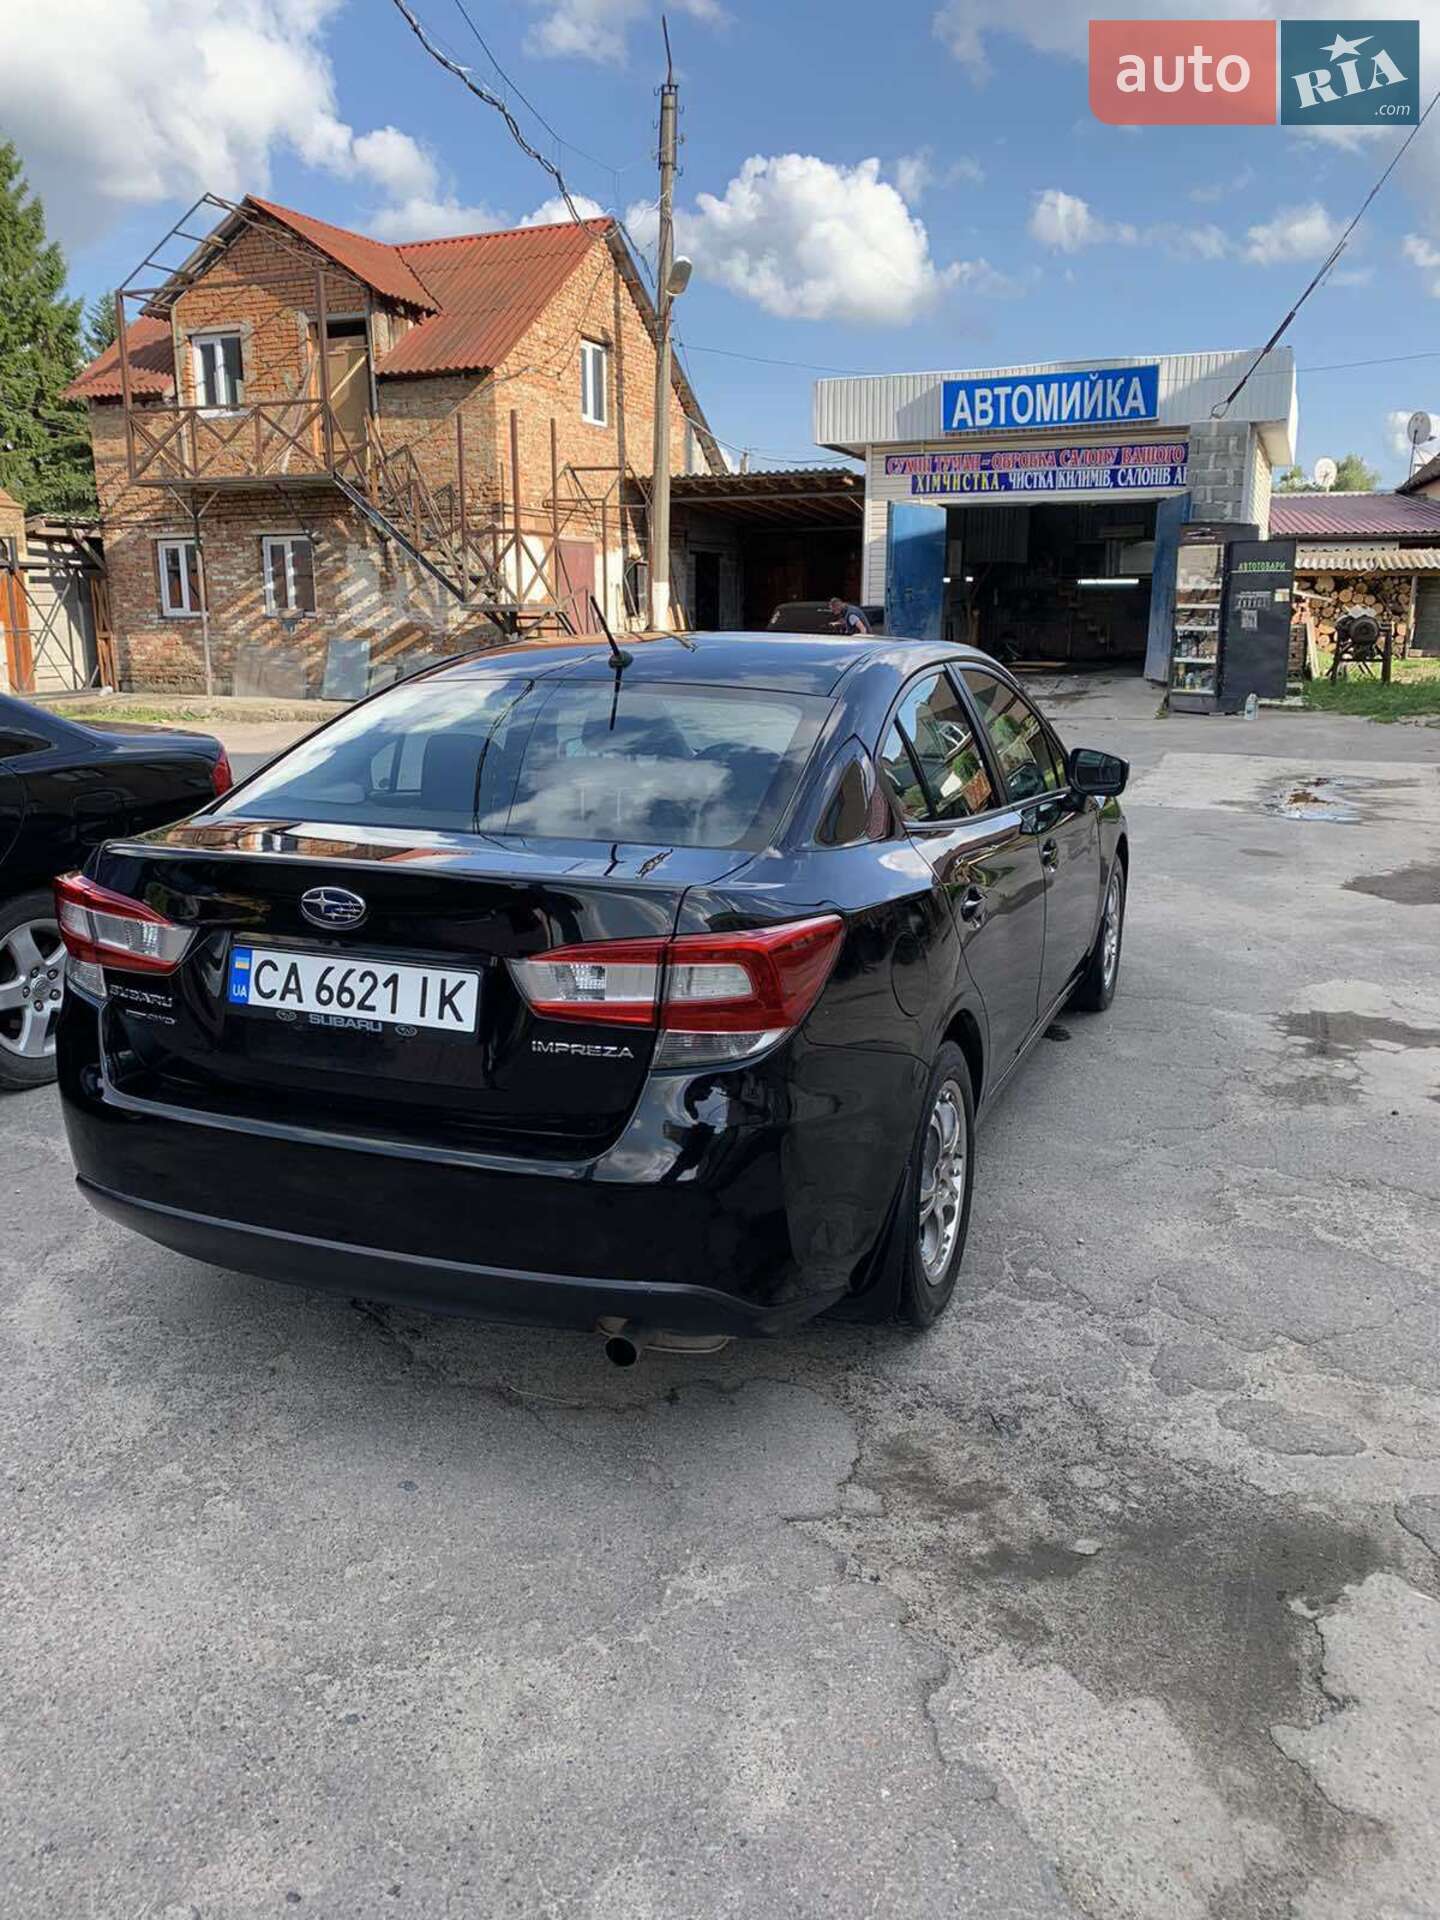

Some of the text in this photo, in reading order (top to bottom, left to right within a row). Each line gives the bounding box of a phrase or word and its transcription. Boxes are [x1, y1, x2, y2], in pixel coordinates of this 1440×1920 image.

[952, 372, 1147, 429] АВТОМИЙКА
[1059, 448, 1120, 468] САЛОНУ
[1121, 445, 1186, 465] ВАШОГО
[1008, 470, 1054, 490] ЧИСТКА
[1117, 467, 1171, 487] САЛОНІВ
[233, 984, 248, 998] UA
[254, 959, 467, 1023] CA 6621 IK
[309, 1013, 382, 1033] SUBARU
[531, 1040, 635, 1059] IMPREZA
